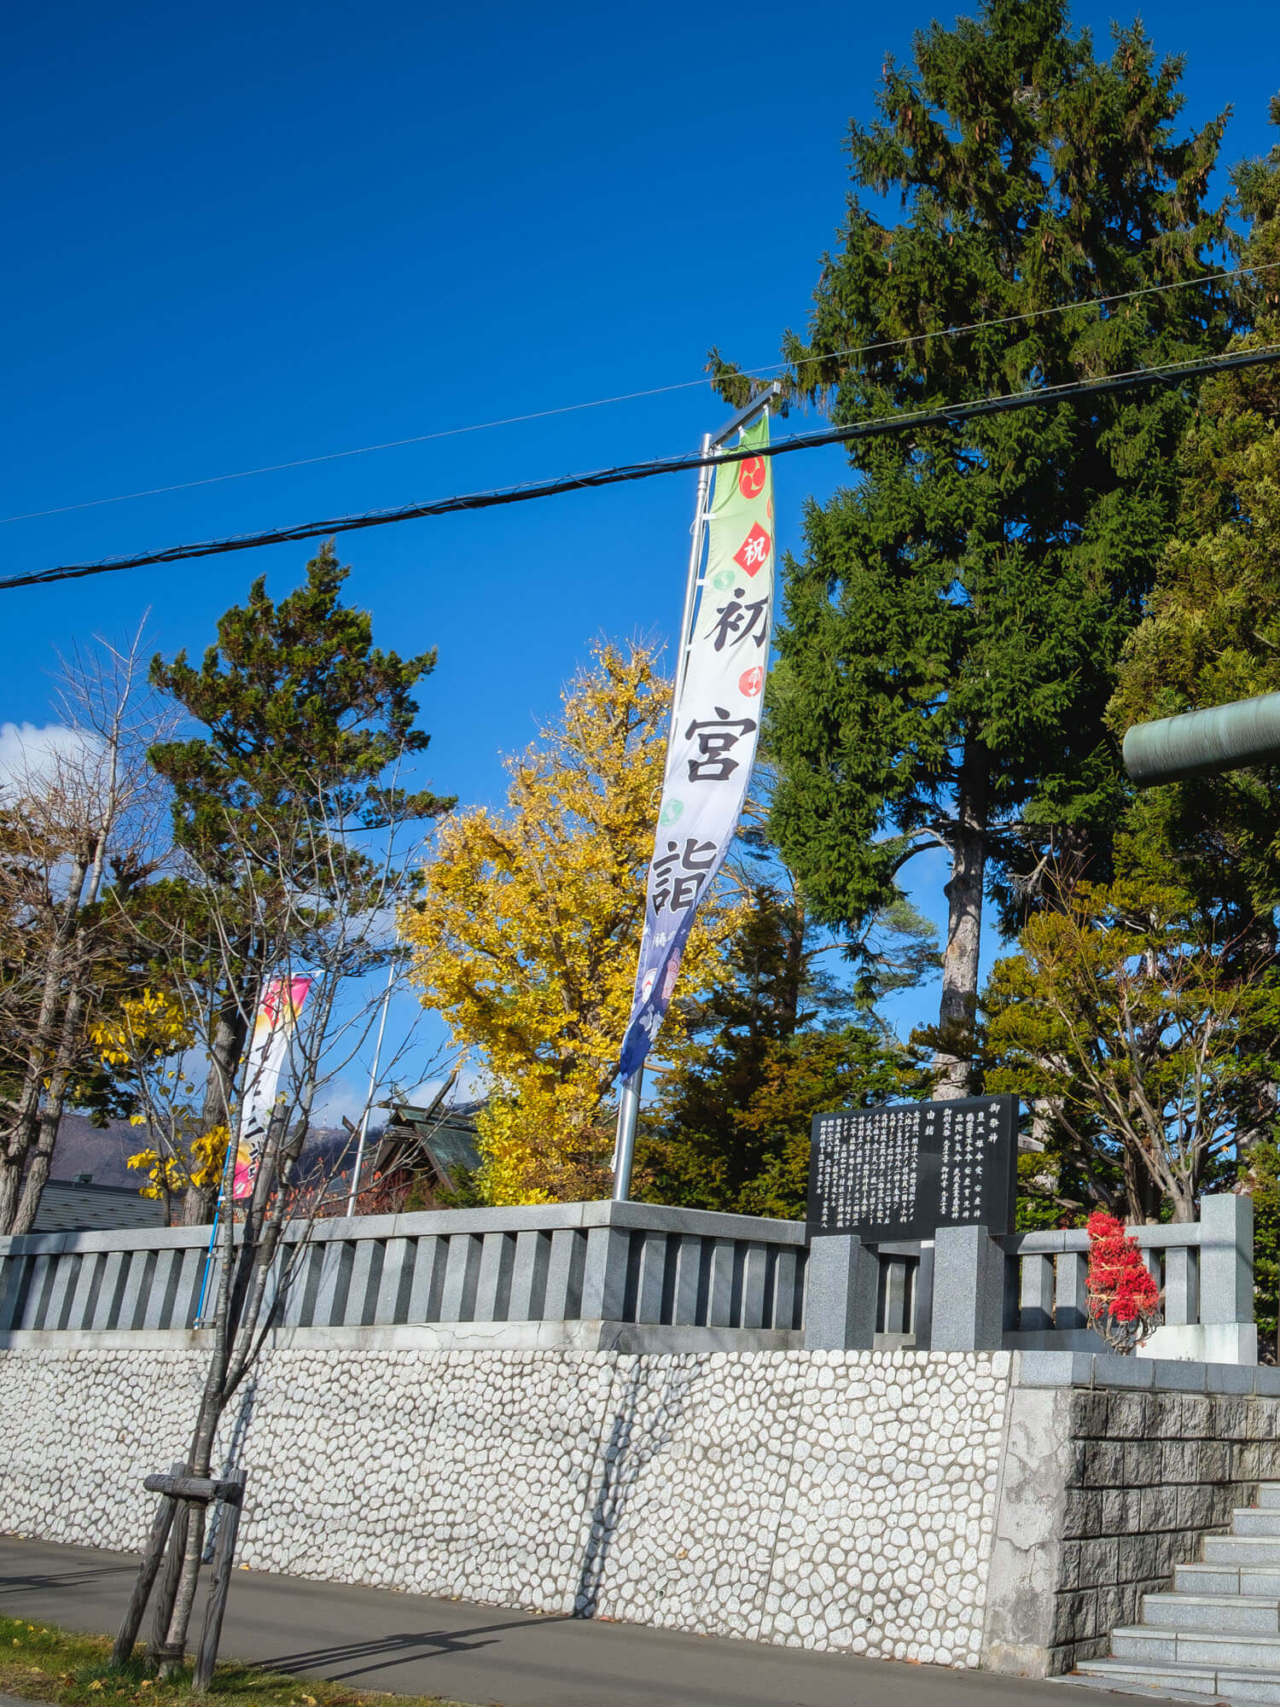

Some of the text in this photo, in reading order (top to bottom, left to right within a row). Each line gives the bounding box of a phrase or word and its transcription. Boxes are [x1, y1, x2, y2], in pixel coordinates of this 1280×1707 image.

[743, 536, 767, 567] 祝
[652, 587, 770, 917] 初宮詣
